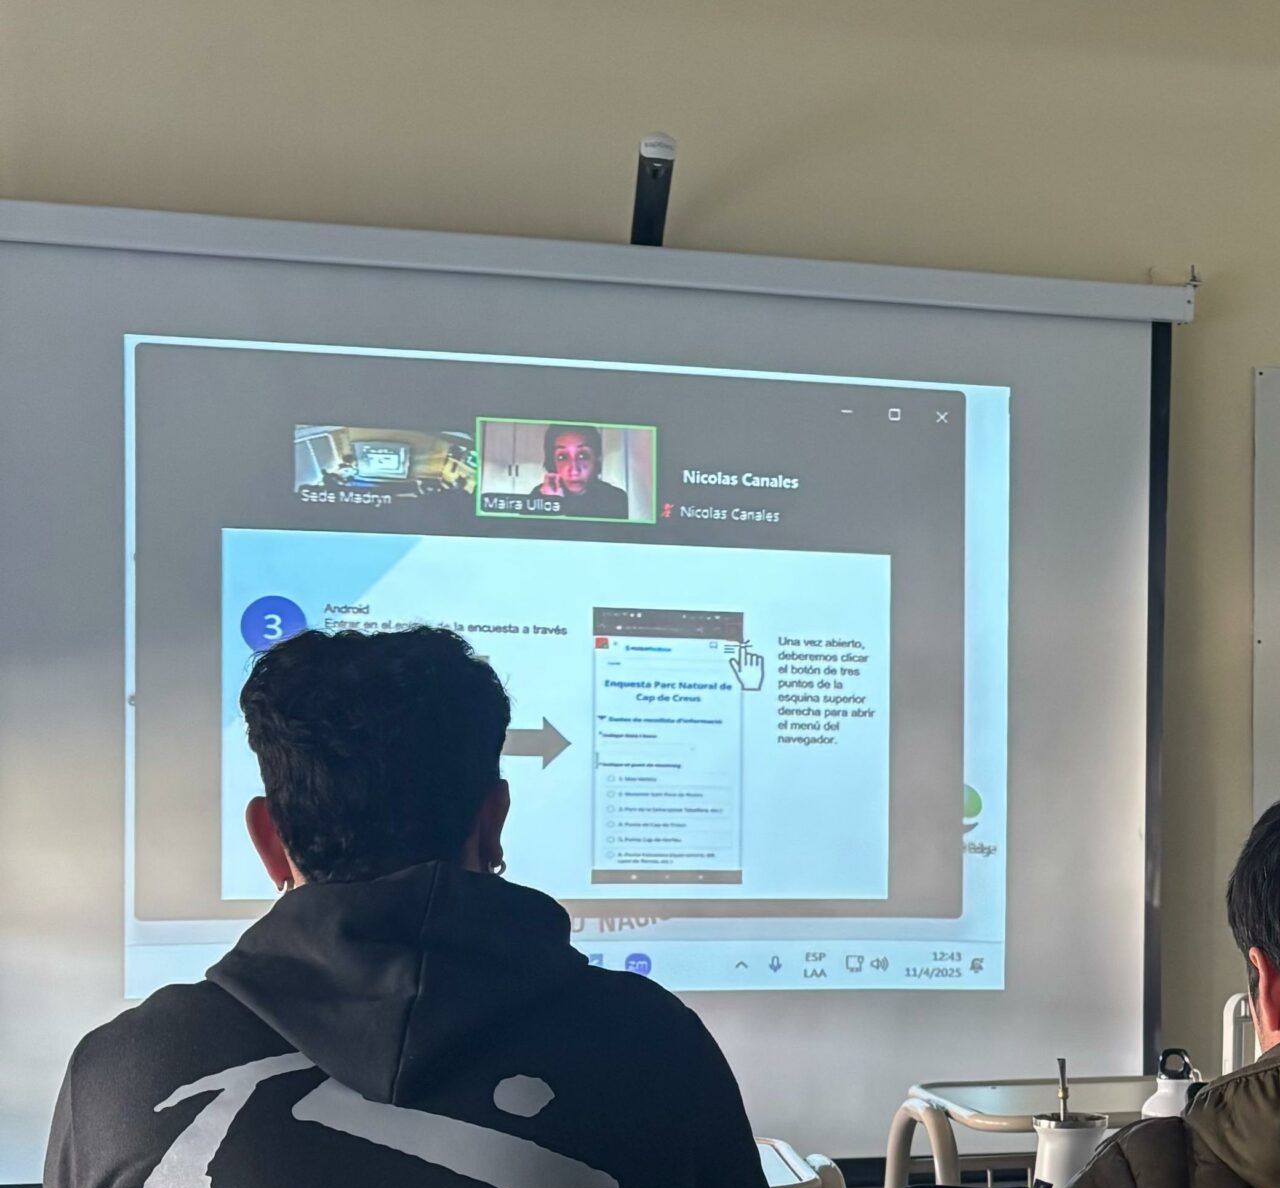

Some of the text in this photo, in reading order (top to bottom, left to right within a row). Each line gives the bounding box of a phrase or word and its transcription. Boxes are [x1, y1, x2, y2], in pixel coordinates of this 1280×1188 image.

[682, 470, 799, 489] Nicolas Canales
[301, 489, 392, 507] Sede Madryn
[484, 497, 560, 512] Maira Ulloa
[680, 506, 780, 522] Nicolas Canales
[324, 603, 370, 615] Android
[263, 613, 283, 640] 3
[467, 623, 519, 634] encuesta
[522, 625, 530, 634] a
[533, 624, 568, 635] través
[778, 636, 865, 650] Una vez abierto,
[778, 650, 869, 663] deberemos clicar
[778, 664, 860, 676] el botón de tres
[604, 679, 732, 691] Enquesta Parc Natural de
[778, 679, 844, 690] puntos de la
[636, 693, 702, 703] Cap de Creus
[778, 692, 866, 706] esquina superior
[778, 706, 875, 719] derecha para abrir
[778, 720, 840, 731] el menú del
[777, 733, 838, 746] navegador.
[805, 951, 962, 962] ESP 12:43
[803, 967, 962, 979] LAA 11/4/2025
